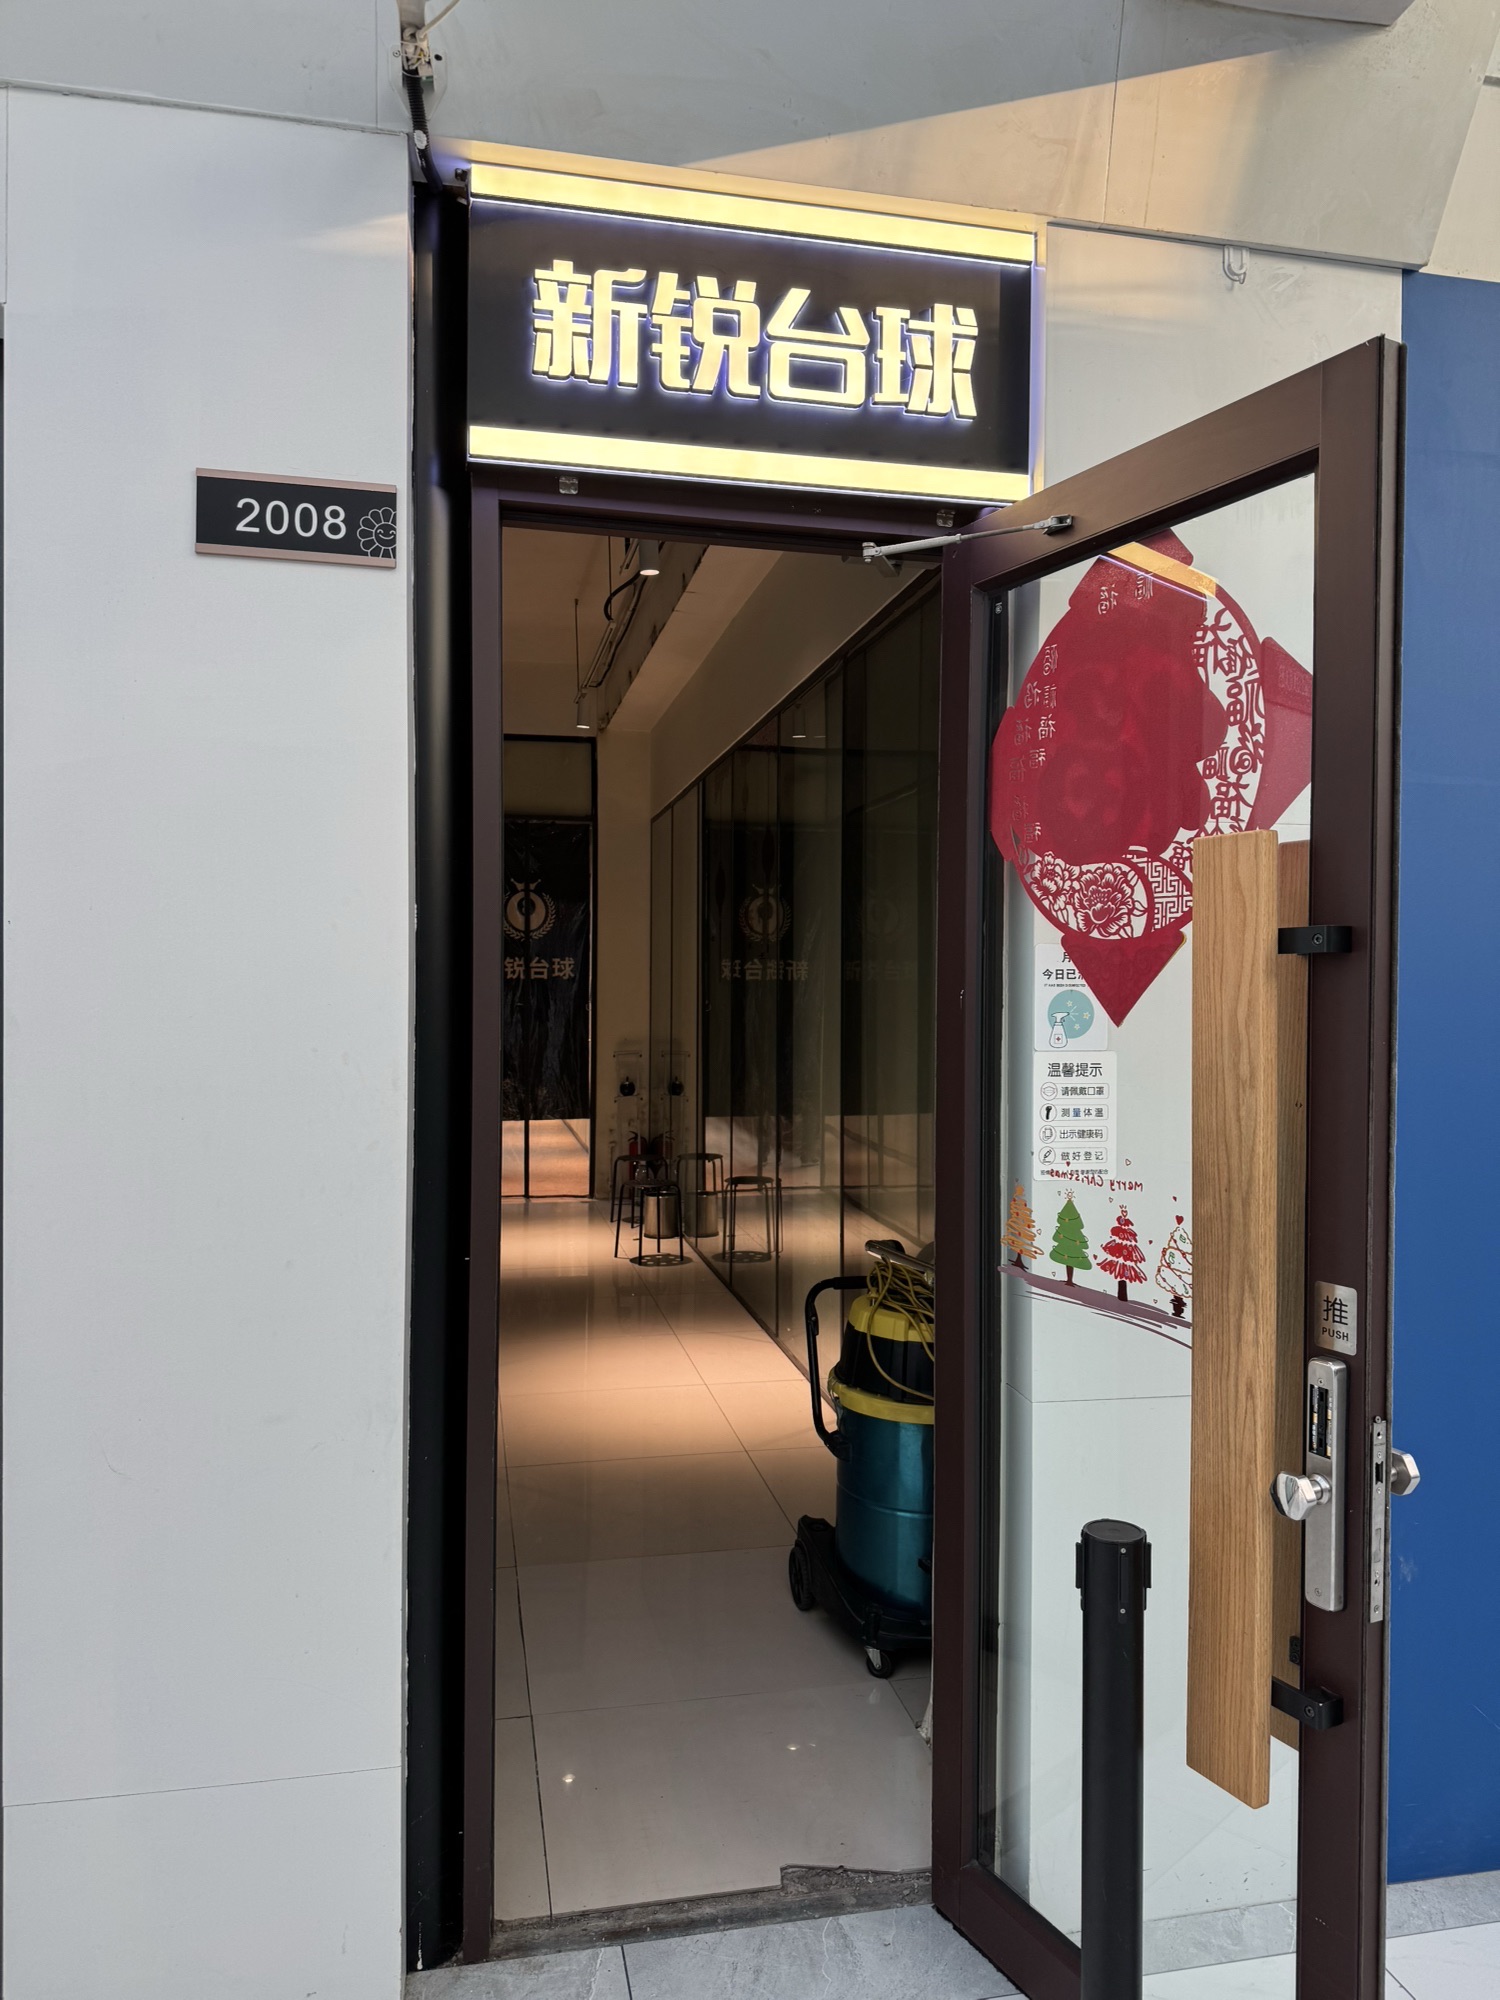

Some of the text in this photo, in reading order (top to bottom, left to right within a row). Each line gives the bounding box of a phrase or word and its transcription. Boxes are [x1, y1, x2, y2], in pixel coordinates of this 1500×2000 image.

[533, 259, 978, 420] 新锐台球
[235, 497, 347, 540] 2008
[504, 956, 575, 980] 锐台球
[1047, 1062, 1102, 1078] 温馨提示
[1061, 1086, 1104, 1097] 请佩戴口罩
[1061, 1107, 1104, 1118] 测量体温
[1059, 1128, 1103, 1140] 出示健康码
[1061, 1151, 1103, 1161] 做好登记
[1323, 1295, 1349, 1326] 推
[1321, 1326, 1349, 1342] PUSH
